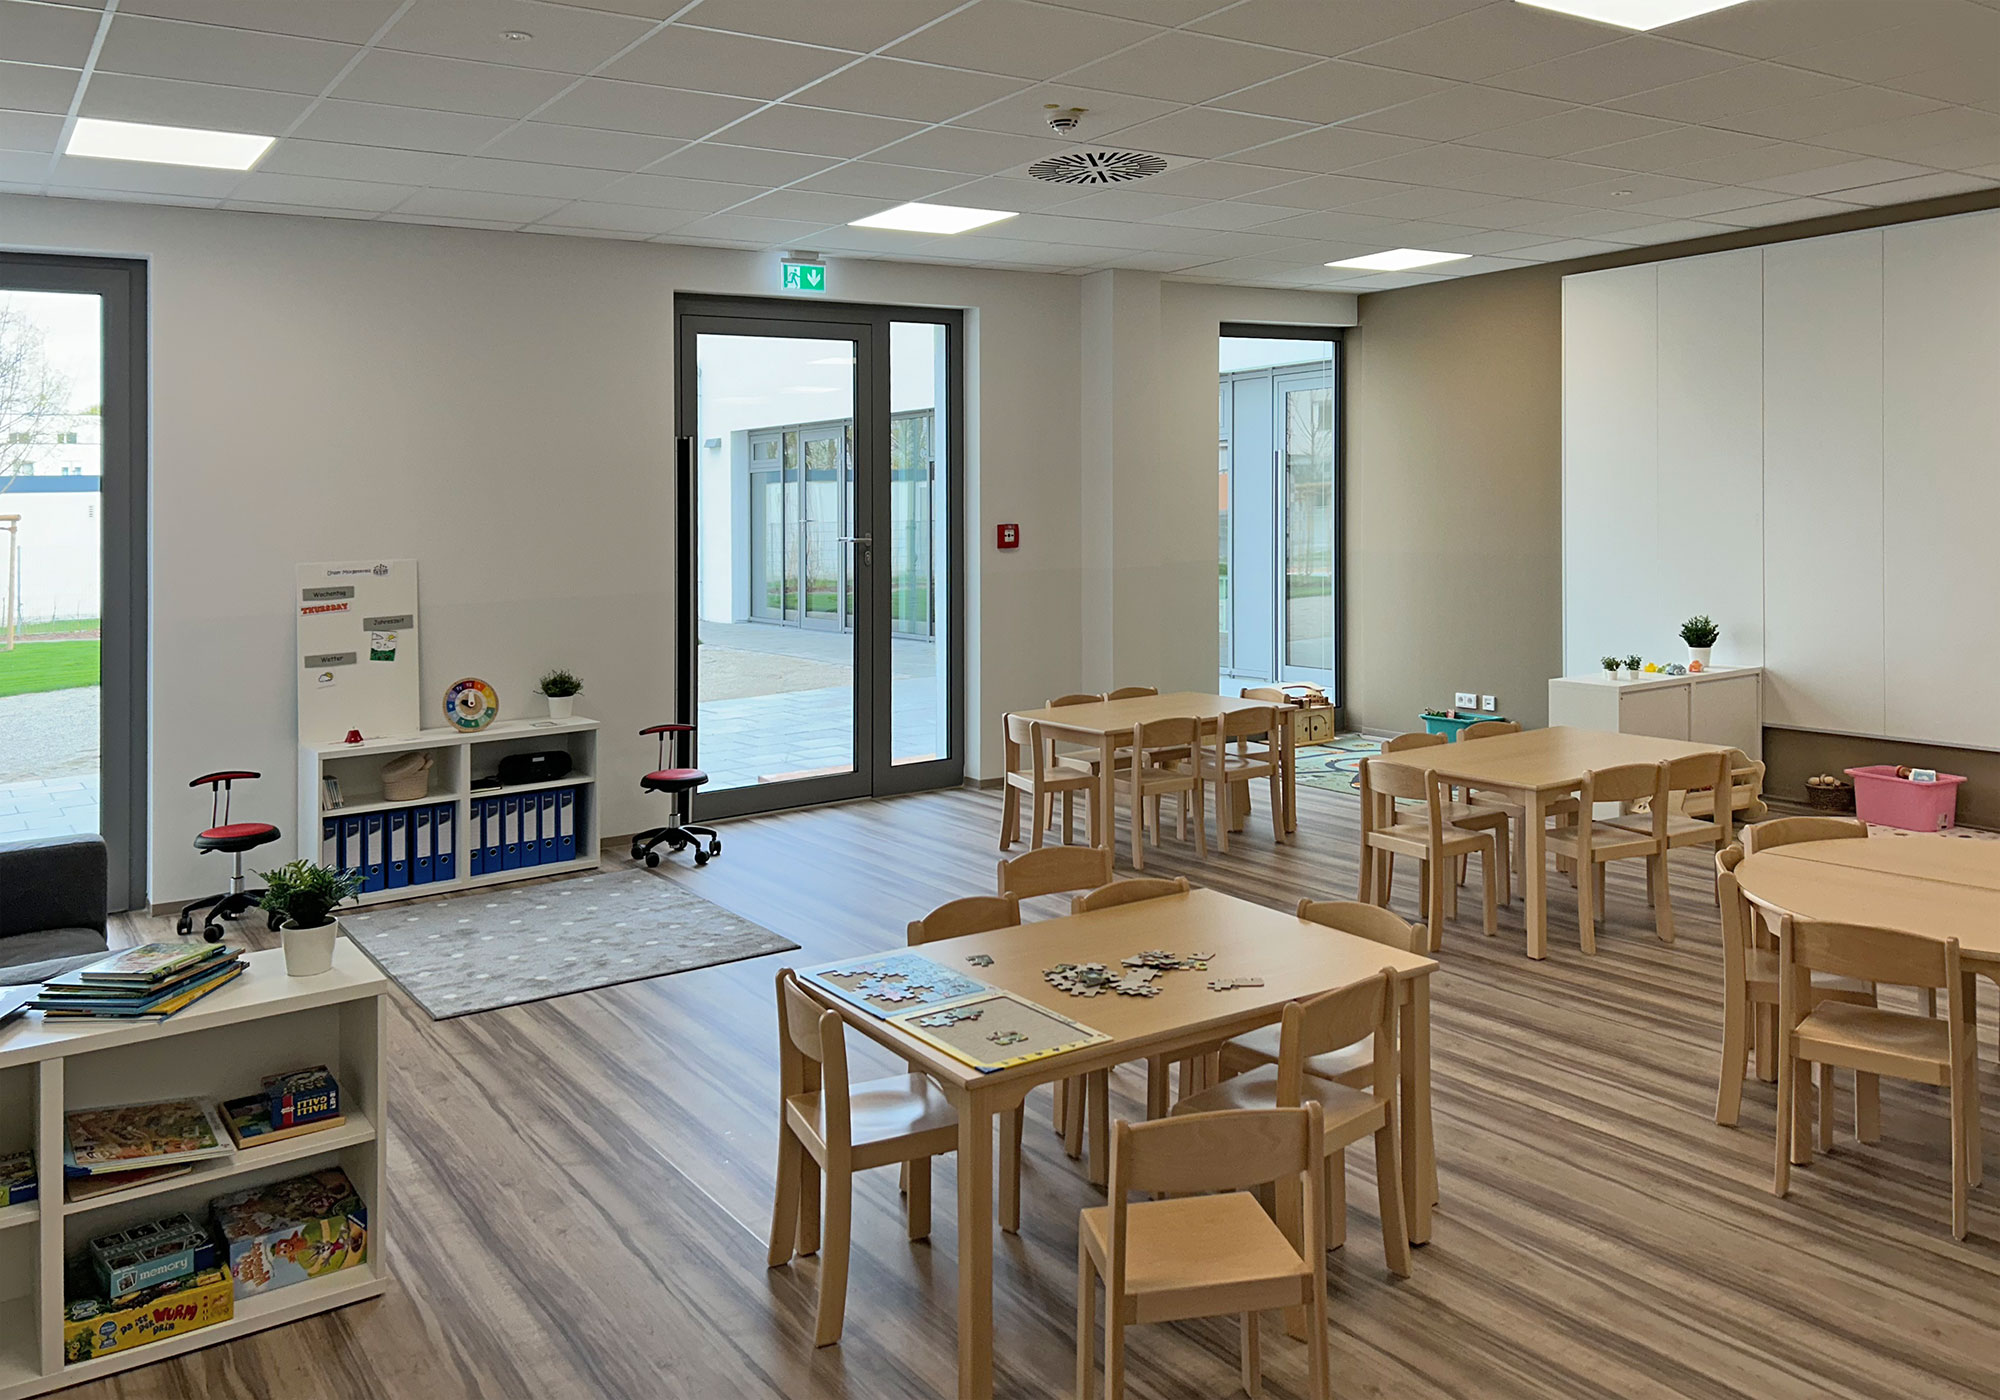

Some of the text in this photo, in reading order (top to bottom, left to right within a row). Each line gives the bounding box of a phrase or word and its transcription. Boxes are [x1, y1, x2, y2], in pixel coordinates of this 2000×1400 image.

[301, 602, 348, 614] THURSDAY
[373, 618, 404, 626] Jahreszeit
[297, 1096, 328, 1109] GALLI
[297, 1103, 328, 1116] HALLI
[140, 1256, 188, 1280] memory
[152, 1303, 198, 1324] WURM
